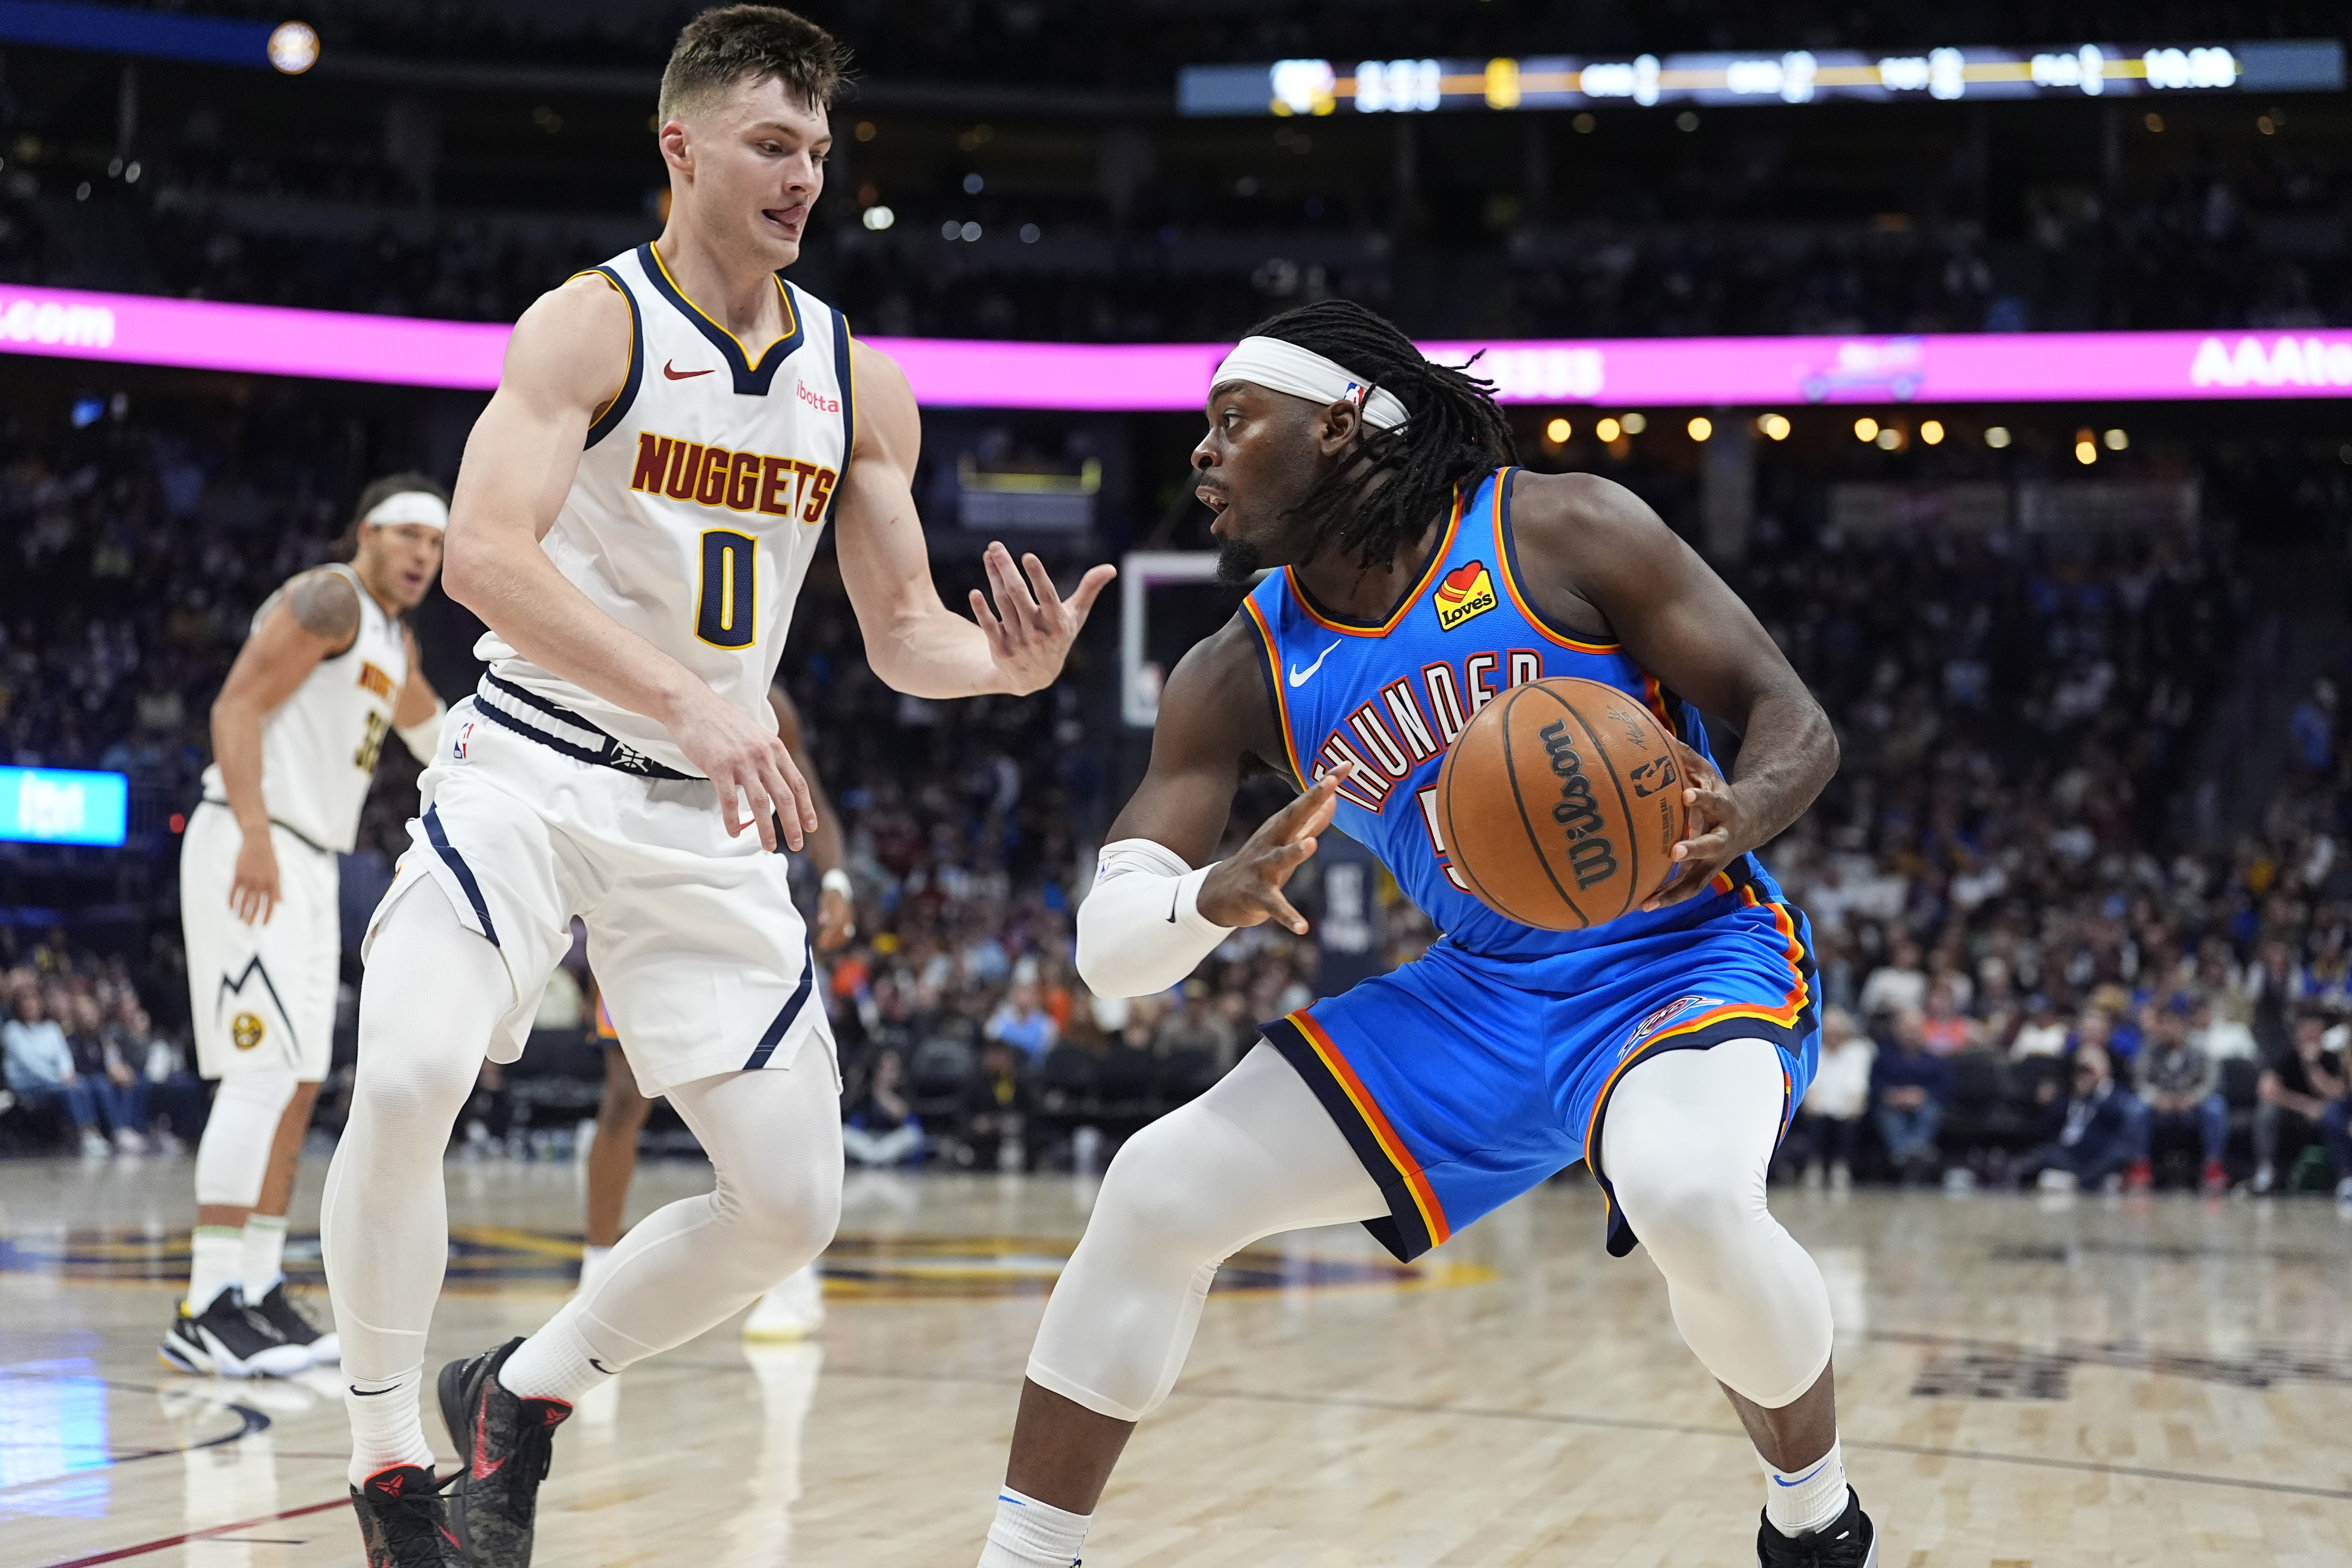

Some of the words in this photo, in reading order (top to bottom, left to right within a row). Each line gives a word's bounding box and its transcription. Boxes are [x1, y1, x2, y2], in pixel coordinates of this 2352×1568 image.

[797, 378, 839, 412] ibotta
[630, 431, 837, 524] NUGGETS
[694, 528, 758, 650] 0
[1537, 717, 1618, 892] Wilson
